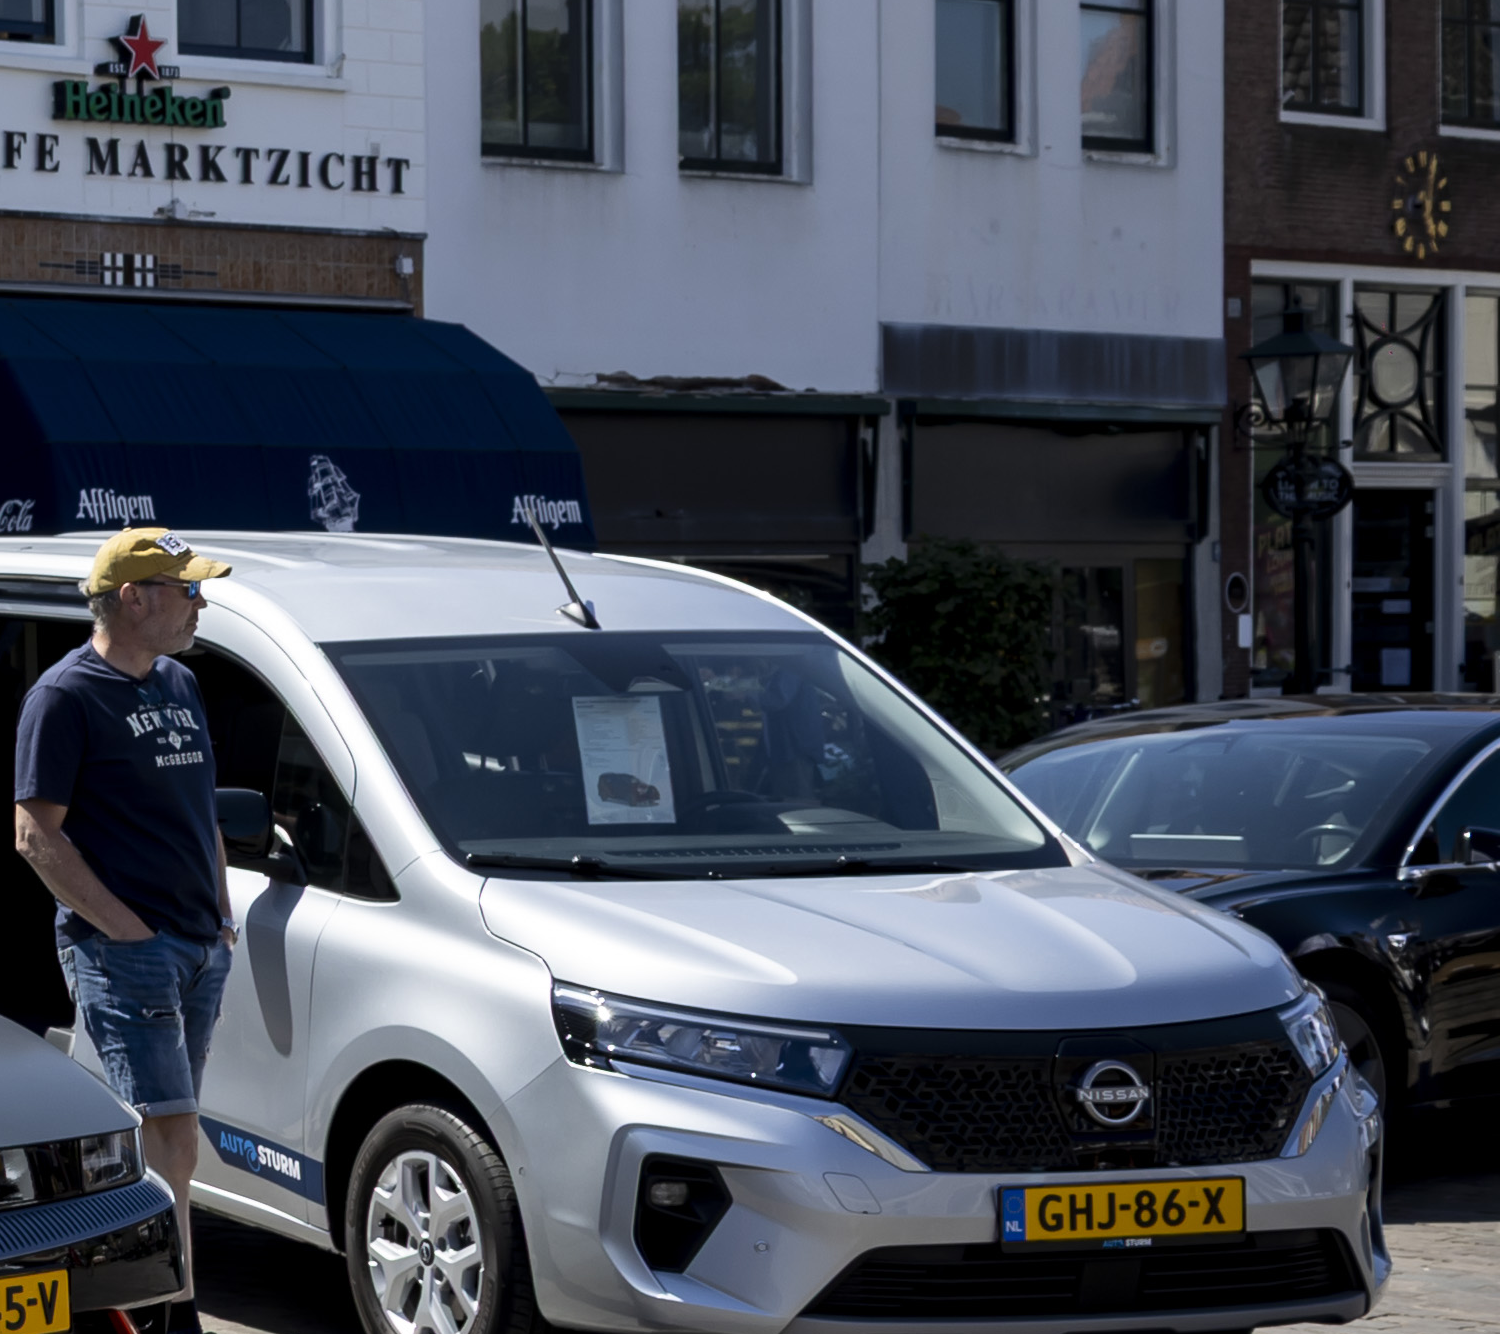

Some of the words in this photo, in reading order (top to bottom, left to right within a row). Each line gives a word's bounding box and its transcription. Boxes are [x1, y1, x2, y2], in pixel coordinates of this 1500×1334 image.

[56, 79, 227, 128] Heineken
[85, 137, 411, 194] MARKTZICHT
[75, 487, 157, 526] Affligem
[510, 494, 583, 530] Affligem
[1078, 1087, 1150, 1101] NISSAN
[257, 1144, 301, 1181] STURM
[1005, 1220, 1023, 1233] NL
[1038, 1186, 1226, 1233] GHJ-86-X
